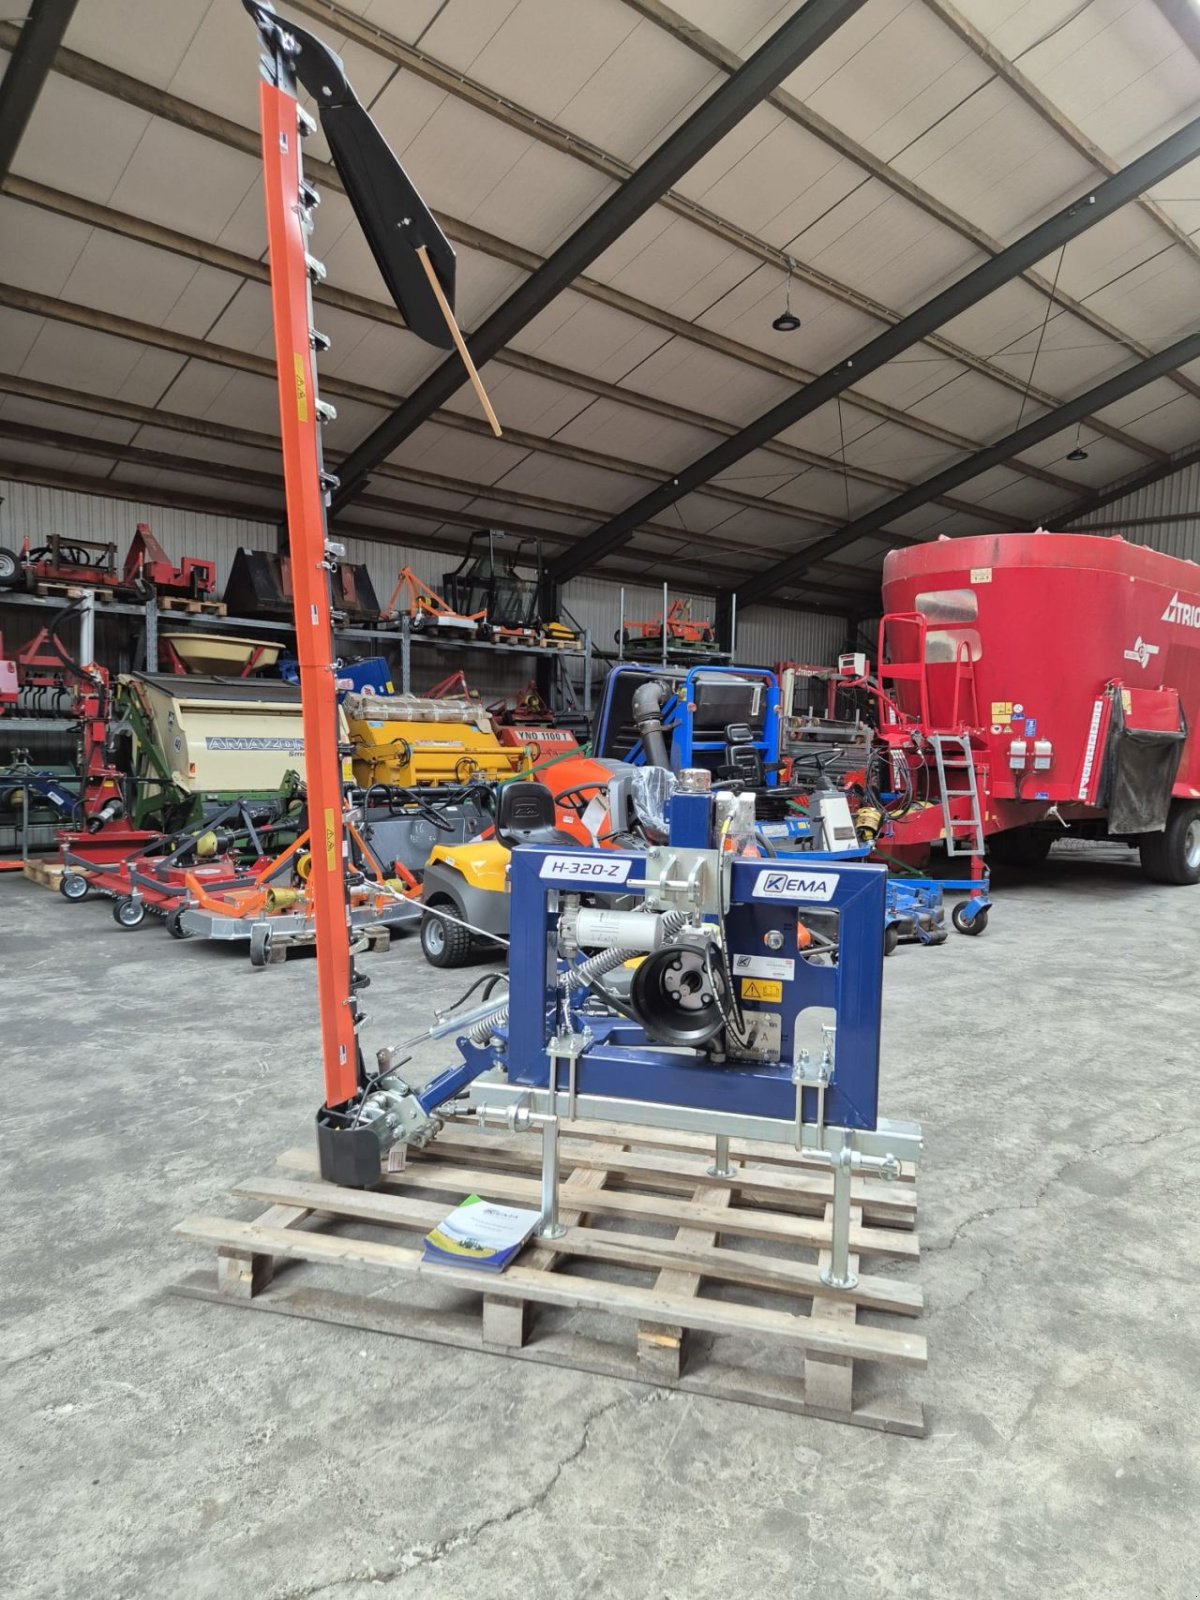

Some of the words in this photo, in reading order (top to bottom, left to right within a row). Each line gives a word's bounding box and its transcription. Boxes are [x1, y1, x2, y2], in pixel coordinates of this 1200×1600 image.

[518, 731, 538, 740] YNO
[541, 732, 562, 741] 1100
[208, 738, 305, 750] AMAZON
[552, 862, 620, 877] H-320-Z
[763, 873, 827, 893] KEMA
